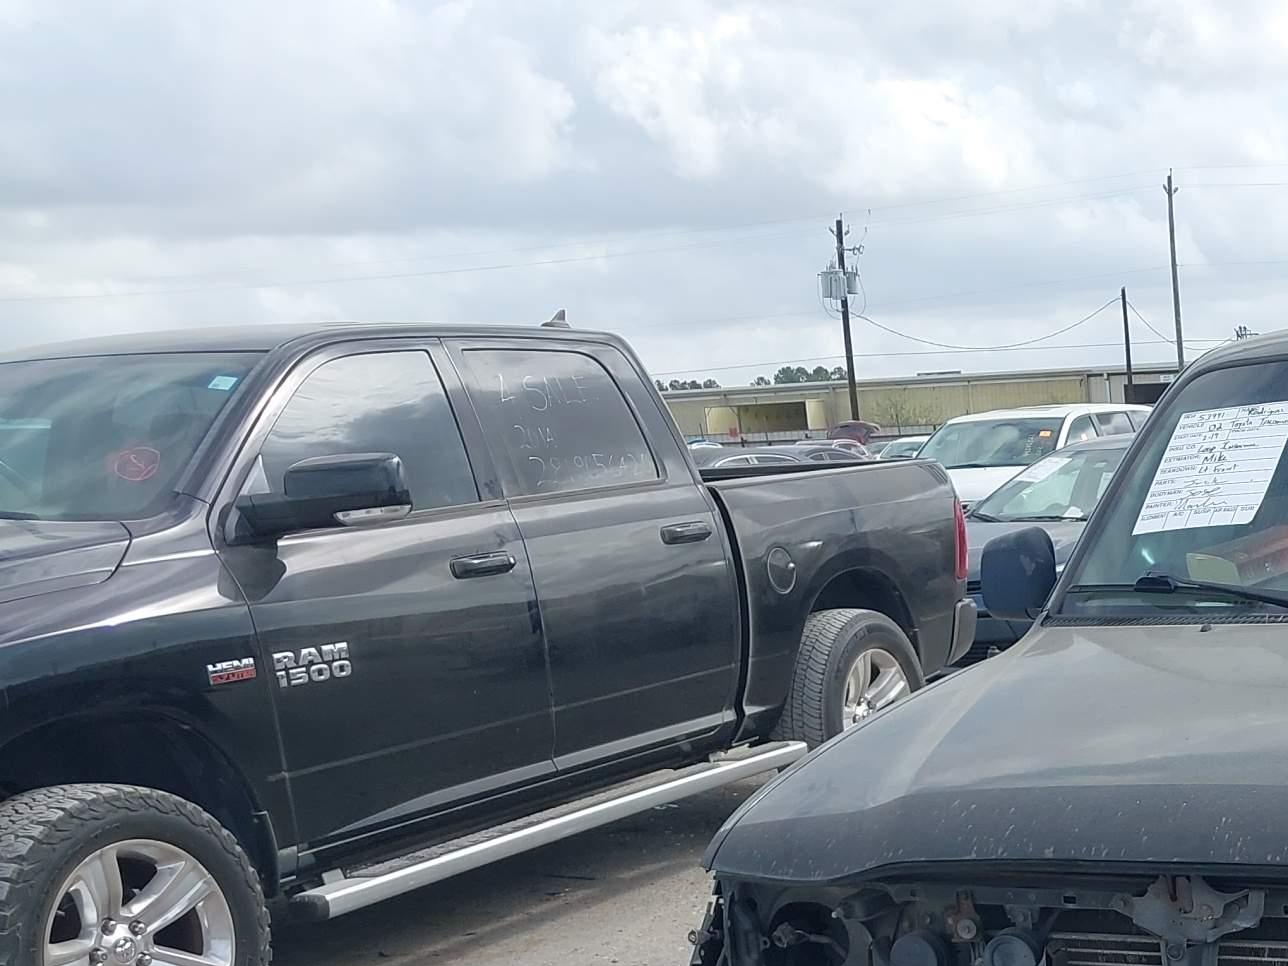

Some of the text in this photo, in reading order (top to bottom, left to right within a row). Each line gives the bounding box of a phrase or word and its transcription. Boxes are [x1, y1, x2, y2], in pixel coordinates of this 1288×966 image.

[521, 374, 590, 411] SALE
[1202, 452, 1228, 463] Mike
[207, 657, 255, 672] HEMI
[272, 641, 351, 671] RAM
[275, 660, 352, 688] 1500
